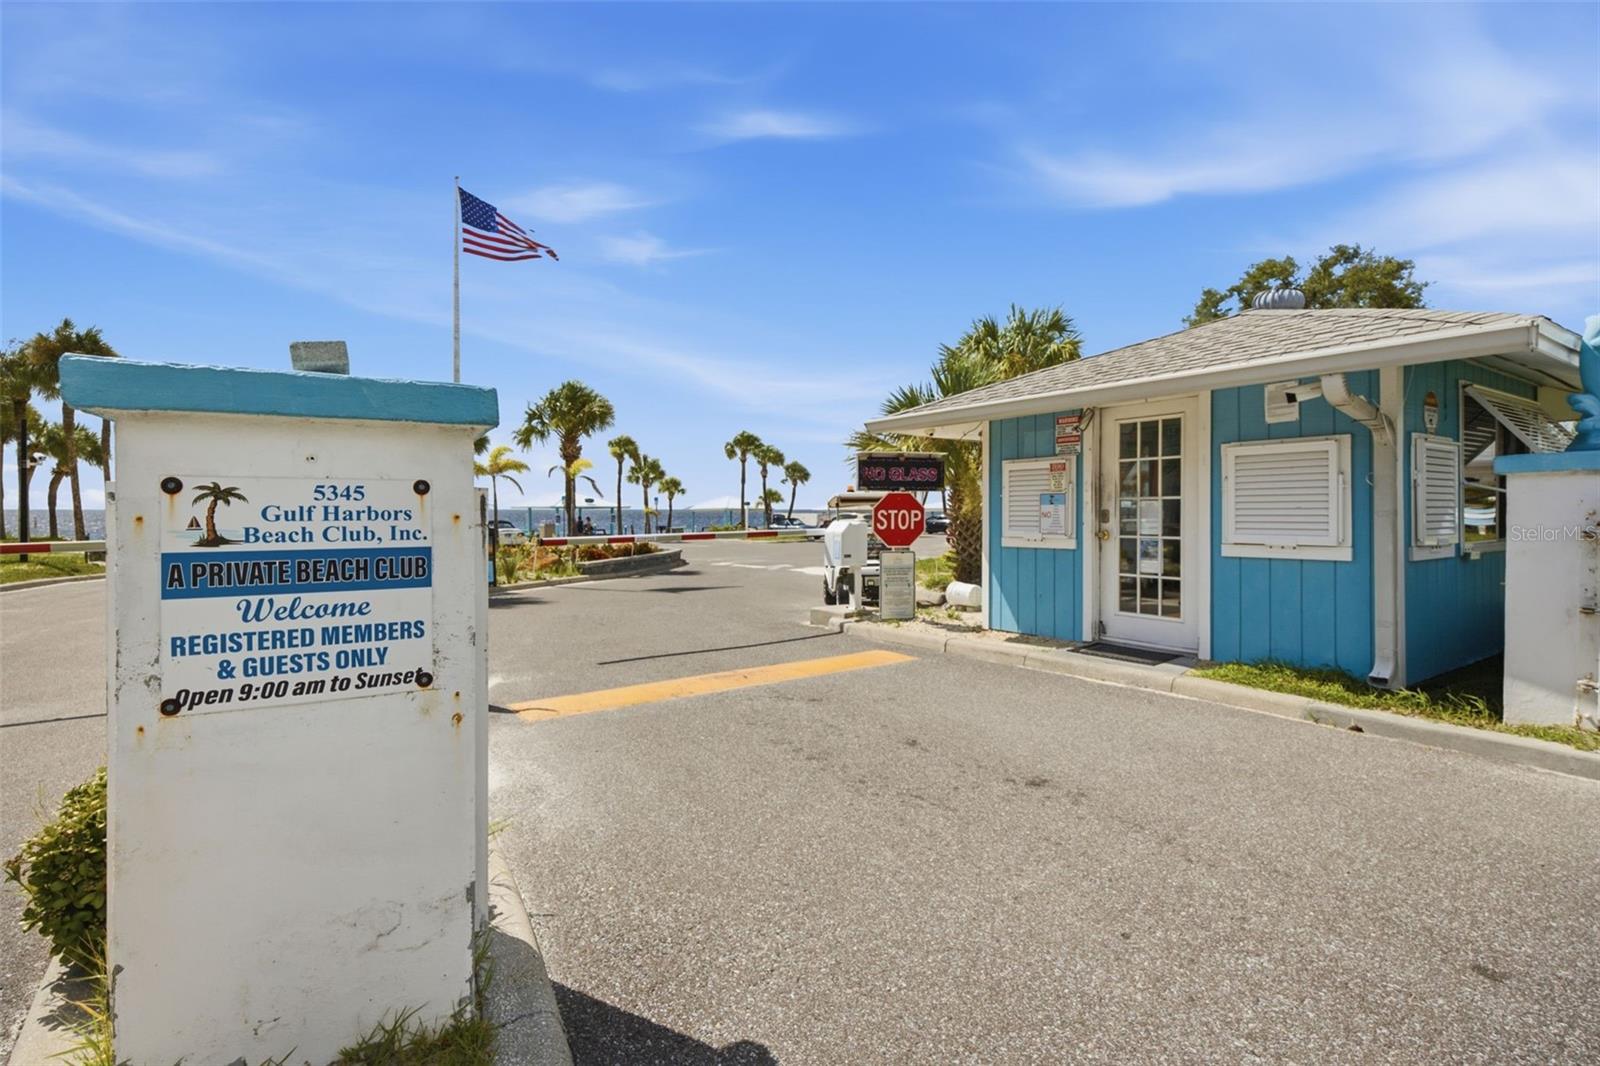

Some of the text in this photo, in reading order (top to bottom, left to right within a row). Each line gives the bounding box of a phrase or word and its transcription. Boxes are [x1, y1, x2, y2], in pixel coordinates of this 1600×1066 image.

[863, 467, 937, 481] NO GLASS
[313, 485, 366, 501] 5345
[260, 505, 413, 522] Gulf Harbors
[876, 509, 922, 531] STOP
[243, 524, 428, 544] Beach Club, Inc.
[166, 556, 427, 589] A PRIVATE BEACH CLUB
[236, 596, 371, 623] Welcome
[170, 620, 425, 657] REGISTERED MEMBERS
[217, 647, 389, 680] & GUESTS ONLY
[175, 667, 423, 711] Open 9:00 am to Sunset
